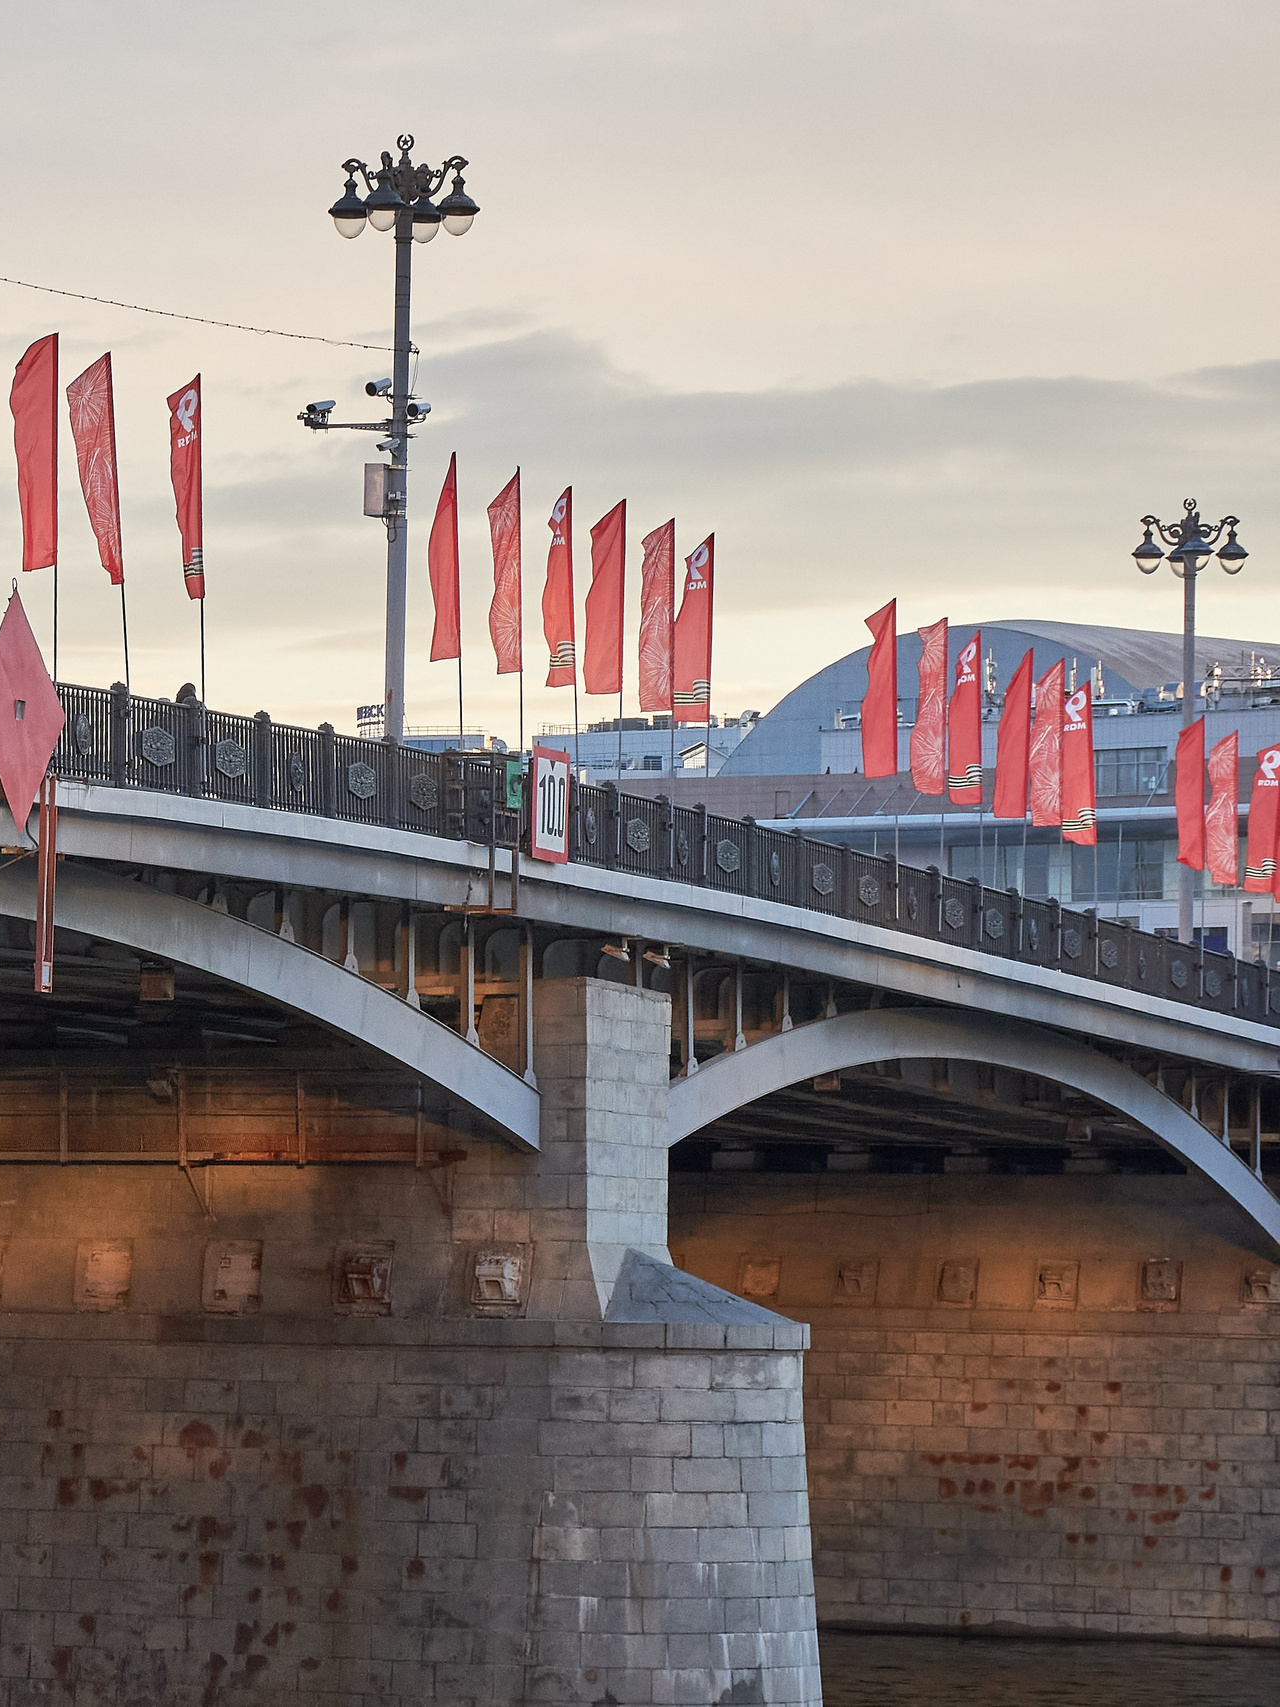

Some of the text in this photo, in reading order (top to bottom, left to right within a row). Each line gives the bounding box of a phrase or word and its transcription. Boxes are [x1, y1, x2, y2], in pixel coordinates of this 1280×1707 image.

[1063, 721, 1087, 733] RDM
[1257, 779, 1280, 787] RDM
[538, 773, 565, 838] 10.0
